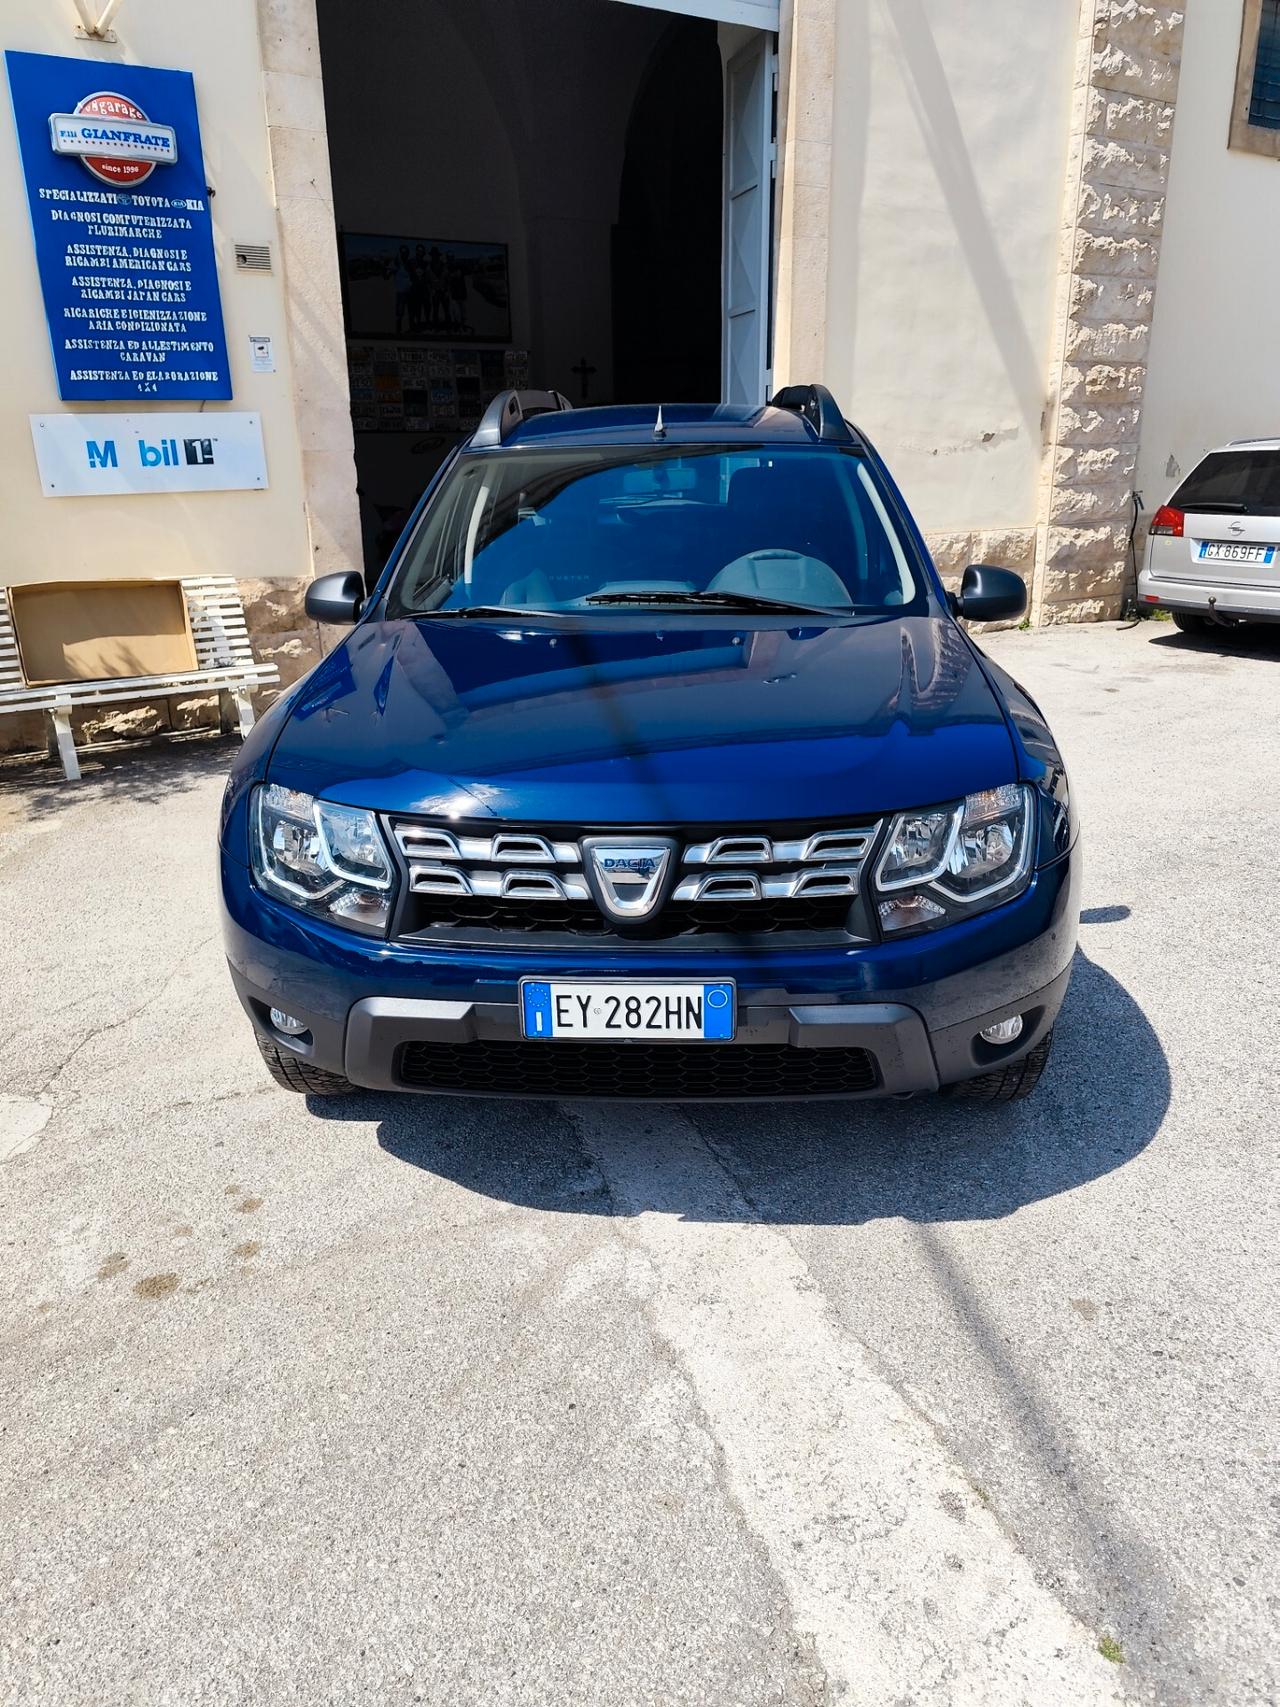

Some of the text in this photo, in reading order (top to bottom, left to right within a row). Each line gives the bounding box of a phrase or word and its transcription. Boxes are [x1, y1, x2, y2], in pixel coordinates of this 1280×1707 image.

[80, 127, 171, 148] GIANFRATE
[101, 163, 122, 173] since
[39, 187, 118, 205] SPECIALIZZATI
[131, 194, 171, 208] TOYOTA
[185, 198, 205, 211] KIA
[51, 209, 193, 230] DIAGNOSI COMPUTERIZZATA
[88, 224, 163, 239] PLURIMARCHE
[67, 243, 188, 260] ASSISTENZA, DIAGNOSI E
[65, 255, 192, 272] RICAMBI AMERICAN CARS
[72, 275, 192, 291] ASSISTENZA, DIAGNOSI E
[81, 288, 186, 302] RICAMBI JAPAN CARS
[63, 307, 207, 322] RICARICHE E IGIENIZZAZIONE
[88, 320, 187, 333] ARIA CONDIZIONATA
[64, 338, 214, 352] ASSISTENZA ED ALLESTIMENTO
[119, 351, 166, 362] CARAVAN
[70, 369, 130, 381] ASSISTENZA
[146, 370, 219, 382] ELABORAZIONE
[1224, 544, 1265, 561] 869FF
[603, 857, 656, 869] DACIA
[555, 994, 592, 1029] EY
[604, 995, 702, 1030] 282HN
